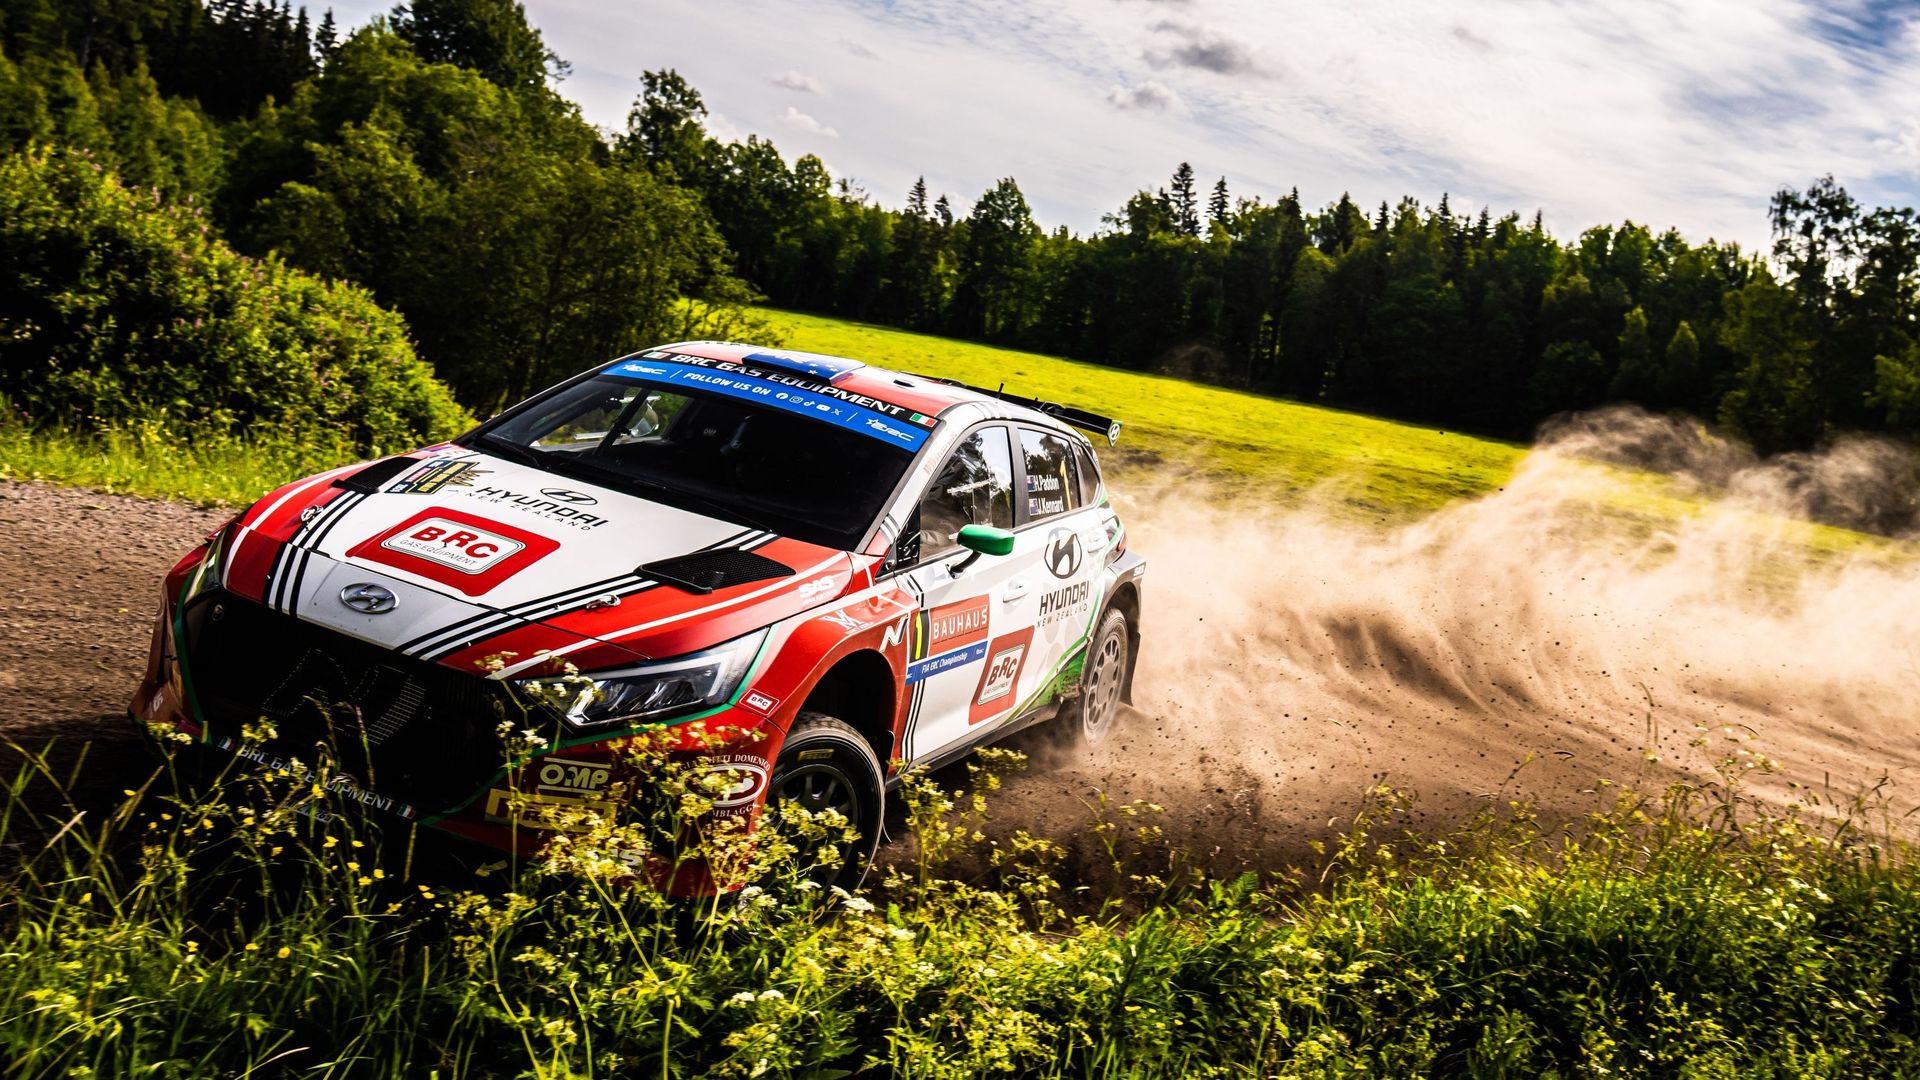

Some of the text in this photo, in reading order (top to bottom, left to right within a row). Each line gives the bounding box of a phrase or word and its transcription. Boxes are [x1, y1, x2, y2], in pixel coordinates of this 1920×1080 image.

[671, 354, 905, 416] BRC GAS EQUIPMENT
[683, 372, 772, 397] FOLLOW US ON
[1034, 474, 1060, 491] H.Paddon
[465, 493, 591, 531] NEW ZEALAND
[475, 487, 609, 527] HYUNDAI
[1038, 496, 1064, 515] J.Kennard
[400, 540, 478, 567] GAS EQUIPMENT
[410, 526, 499, 558] BRC
[1039, 580, 1089, 616] HYUNDAI
[914, 611, 923, 660] 1
[933, 606, 988, 640] BAUHAUS
[1037, 616, 1052, 628] NEW
[922, 652, 968, 675] FIA ERC Championship
[987, 656, 1018, 687] BRC
[751, 696, 769, 707] BRC
[235, 744, 269, 764] BRC
[304, 769, 395, 811] EUIPMENT
[539, 763, 609, 790] OMP
[734, 754, 771, 773] DOMENICO
